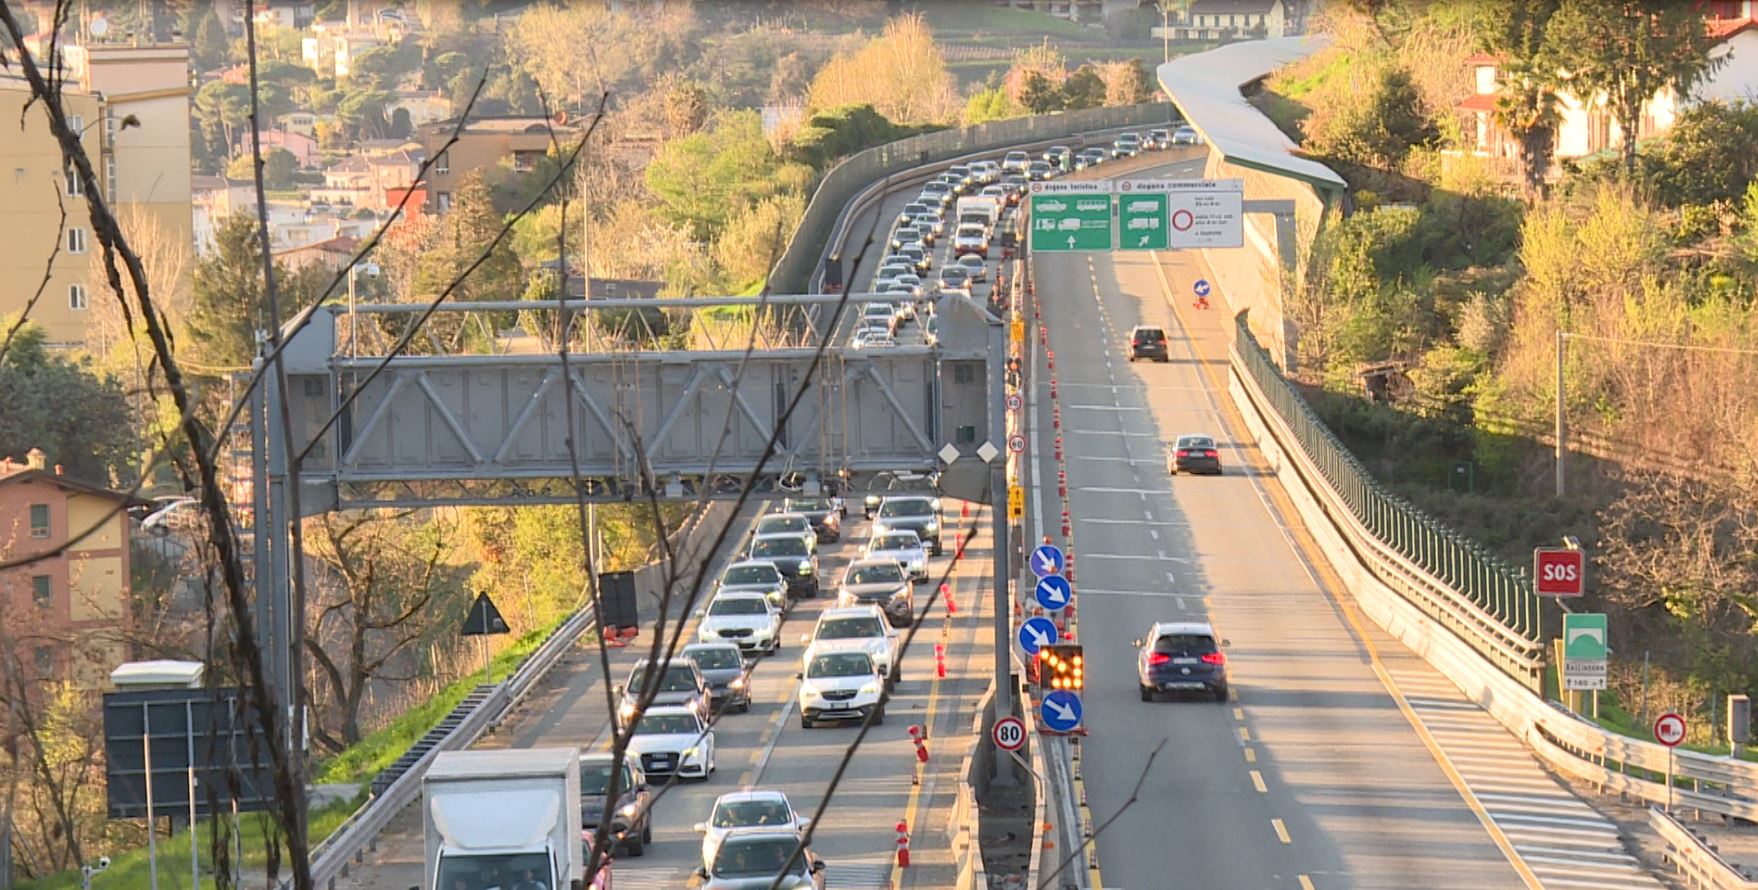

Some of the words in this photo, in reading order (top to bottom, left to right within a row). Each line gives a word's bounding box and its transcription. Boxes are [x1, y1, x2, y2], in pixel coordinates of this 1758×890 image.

[1045, 183, 1067, 191] dogana
[1168, 181, 1216, 189] commerciale
[1543, 562, 1577, 582] SOS
[1000, 725, 1020, 742] 80
